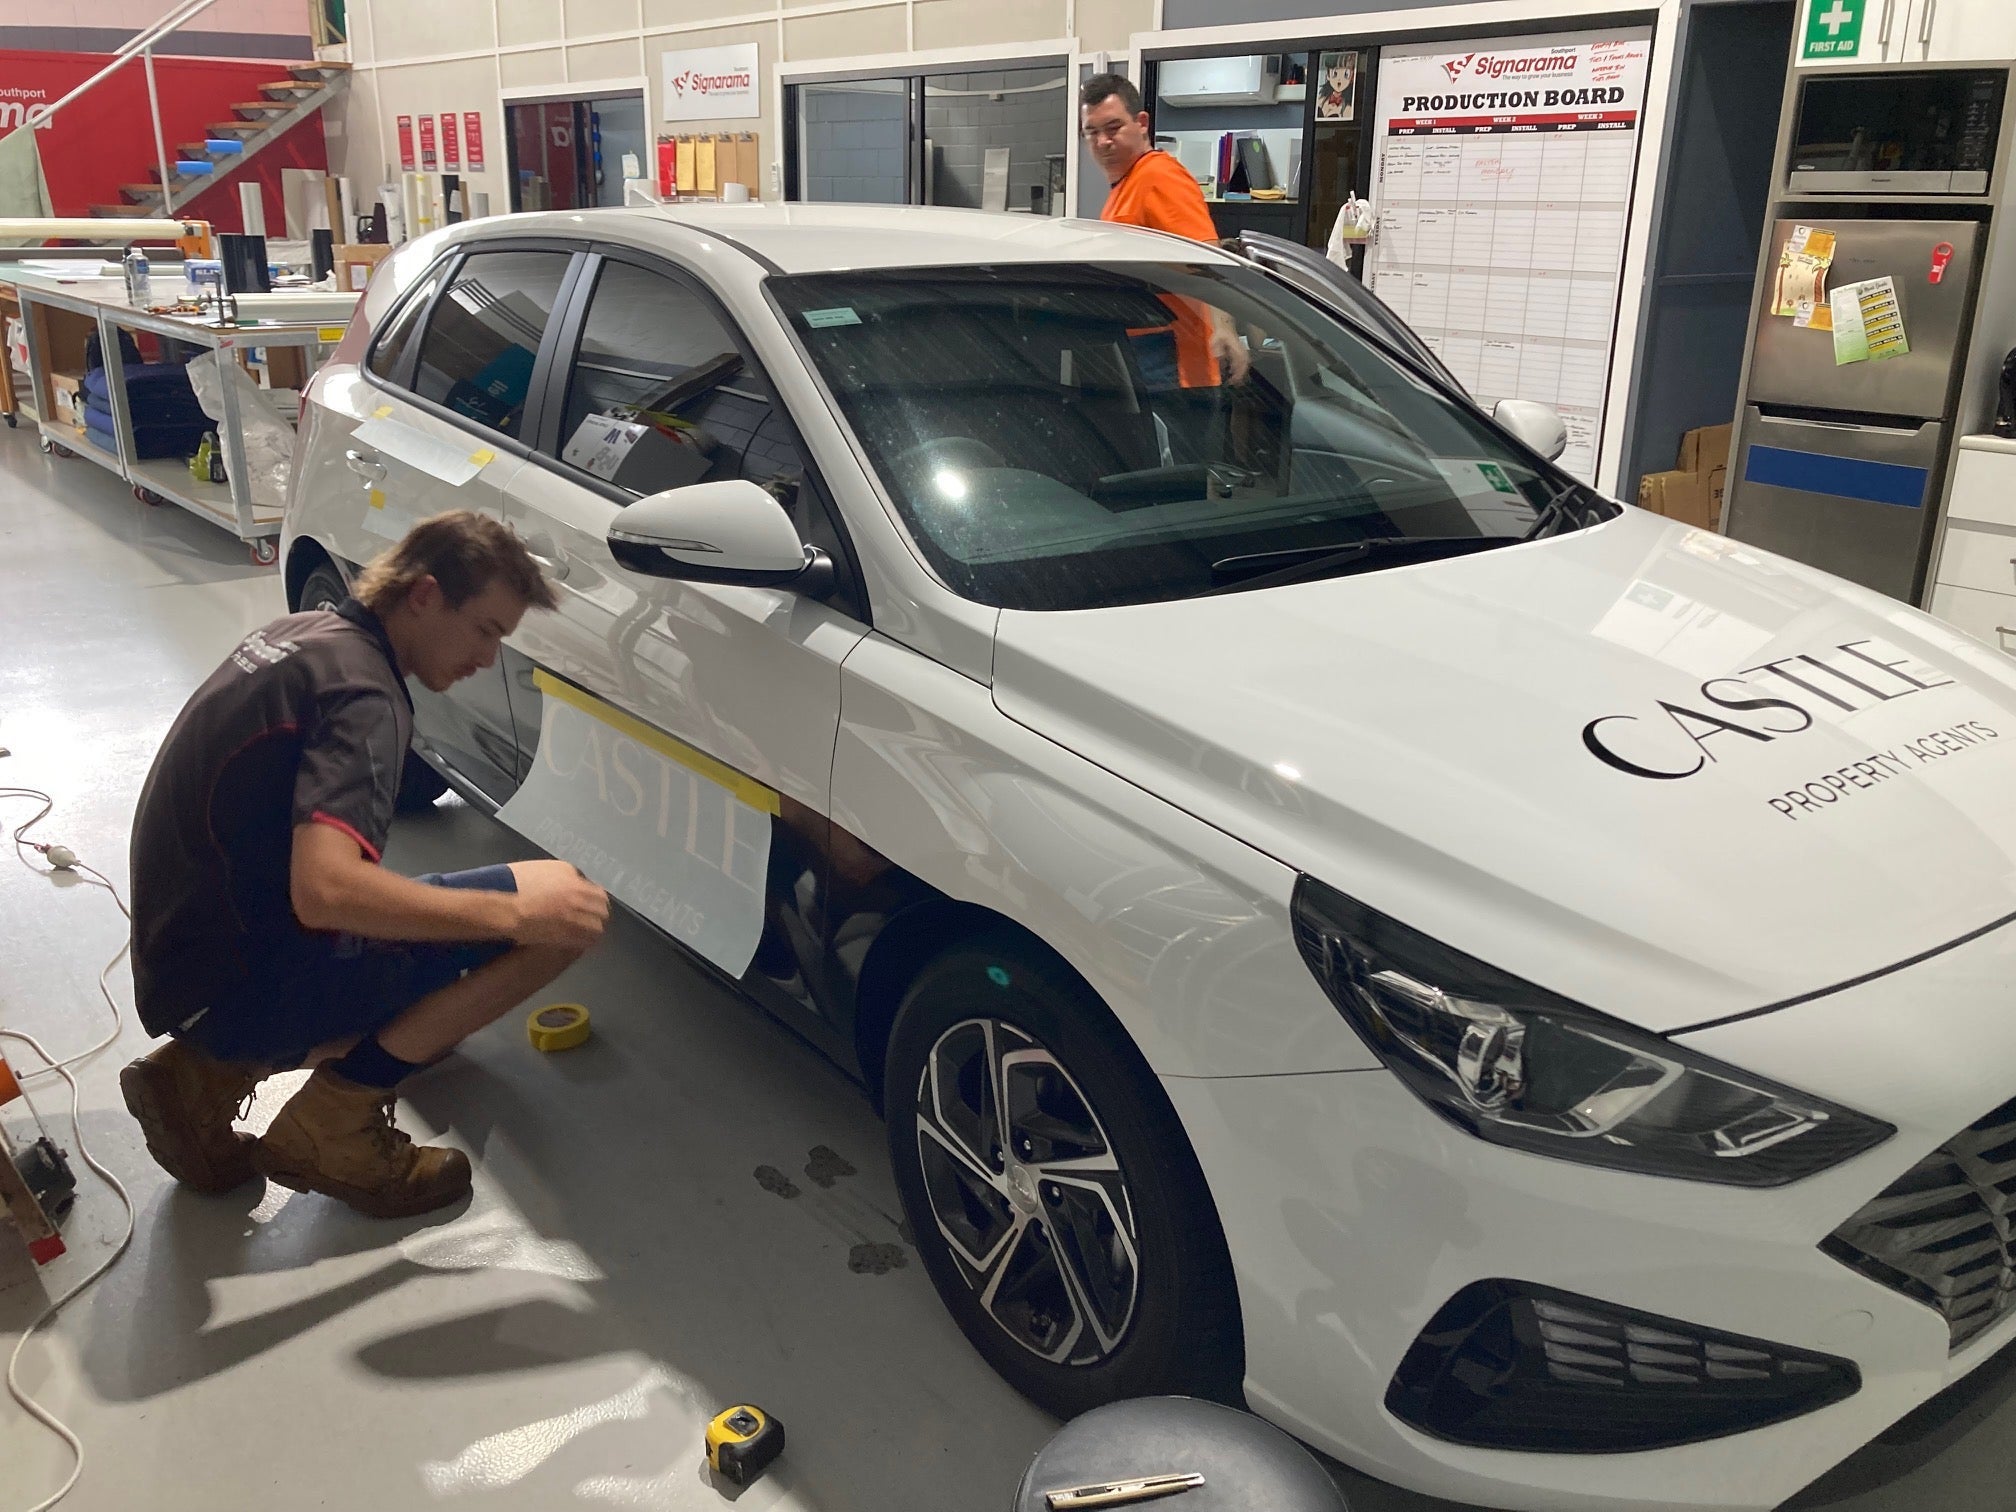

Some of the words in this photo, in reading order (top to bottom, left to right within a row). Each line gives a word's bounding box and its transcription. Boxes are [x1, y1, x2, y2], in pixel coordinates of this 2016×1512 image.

[1809, 41, 1836, 52] FIRST
[1837, 40, 1854, 51] AID
[1475, 55, 1577, 79] Signarama
[691, 73, 750, 95] Signarama
[1402, 90, 1539, 112] PRODUCTION
[1543, 86, 1625, 107] BOARD
[1582, 640, 1955, 780] CASTLE
[1767, 750, 1912, 821] PROPERTY
[1904, 721, 1999, 763] AGENTS
[543, 701, 766, 896] CASTLE
